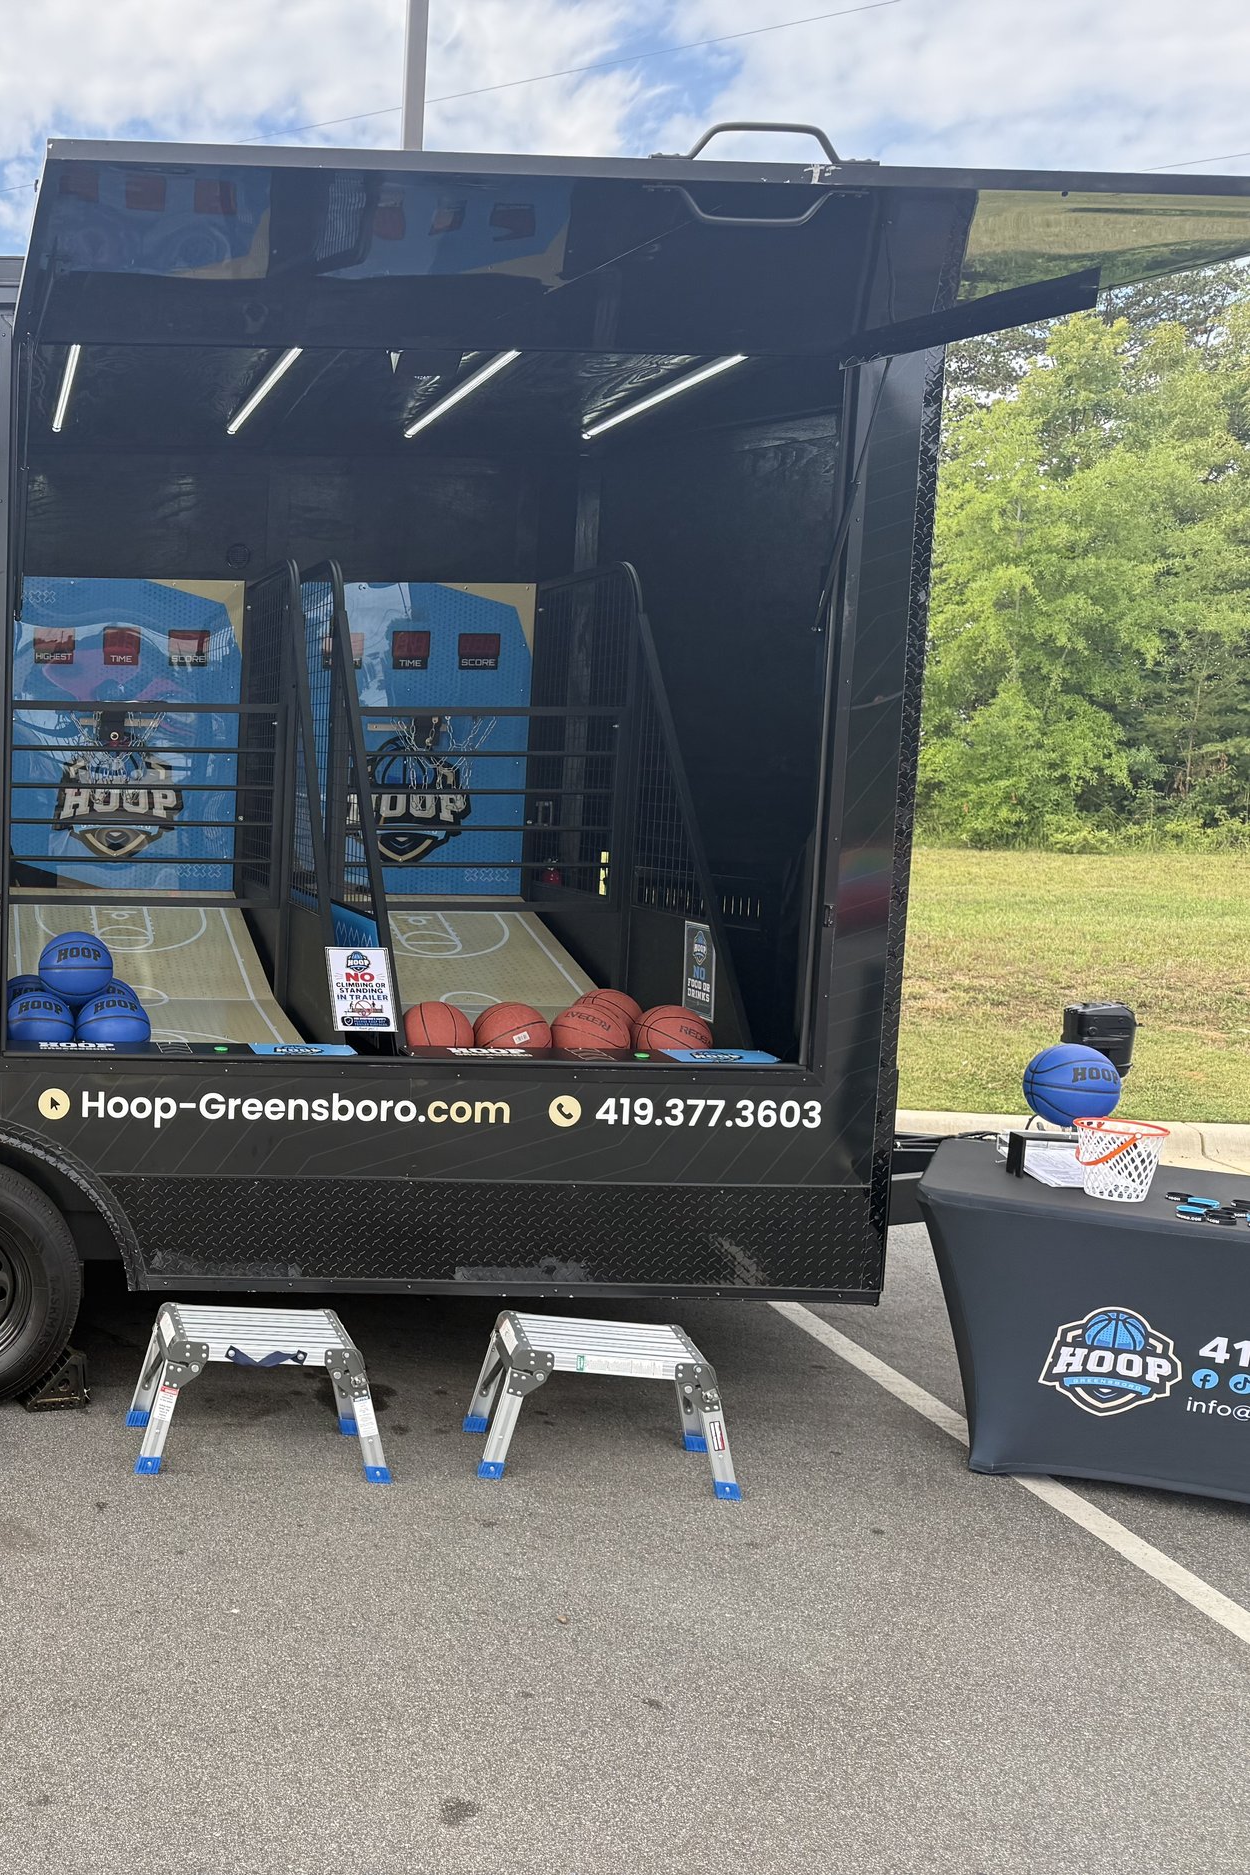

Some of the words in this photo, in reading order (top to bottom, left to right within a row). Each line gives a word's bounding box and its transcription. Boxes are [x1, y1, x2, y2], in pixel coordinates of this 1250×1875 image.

[35, 652, 72, 661] HIGHEST
[110, 655, 132, 663] TIME
[171, 655, 206, 663] SCORE
[399, 659, 422, 667] TIME
[461, 658, 496, 667] SCORE
[59, 788, 177, 819] HOOP
[57, 947, 101, 963] HOOP
[347, 959, 370, 967] HOOP
[345, 972, 375, 982] NO
[693, 965, 706, 981] NO
[687, 978, 702, 990] FOOD
[702, 982, 711, 992] OR
[687, 988, 710, 1002] DRINKS
[18, 1000, 63, 1015] HOOP
[94, 999, 138, 1015] HOOP
[1071, 1067, 1119, 1085] HOOP
[81, 1091, 510, 1128] Hoop-Greensboro.com
[595, 1097, 822, 1129] 419.377.3603
[1052, 1346, 1171, 1383] HOOP
